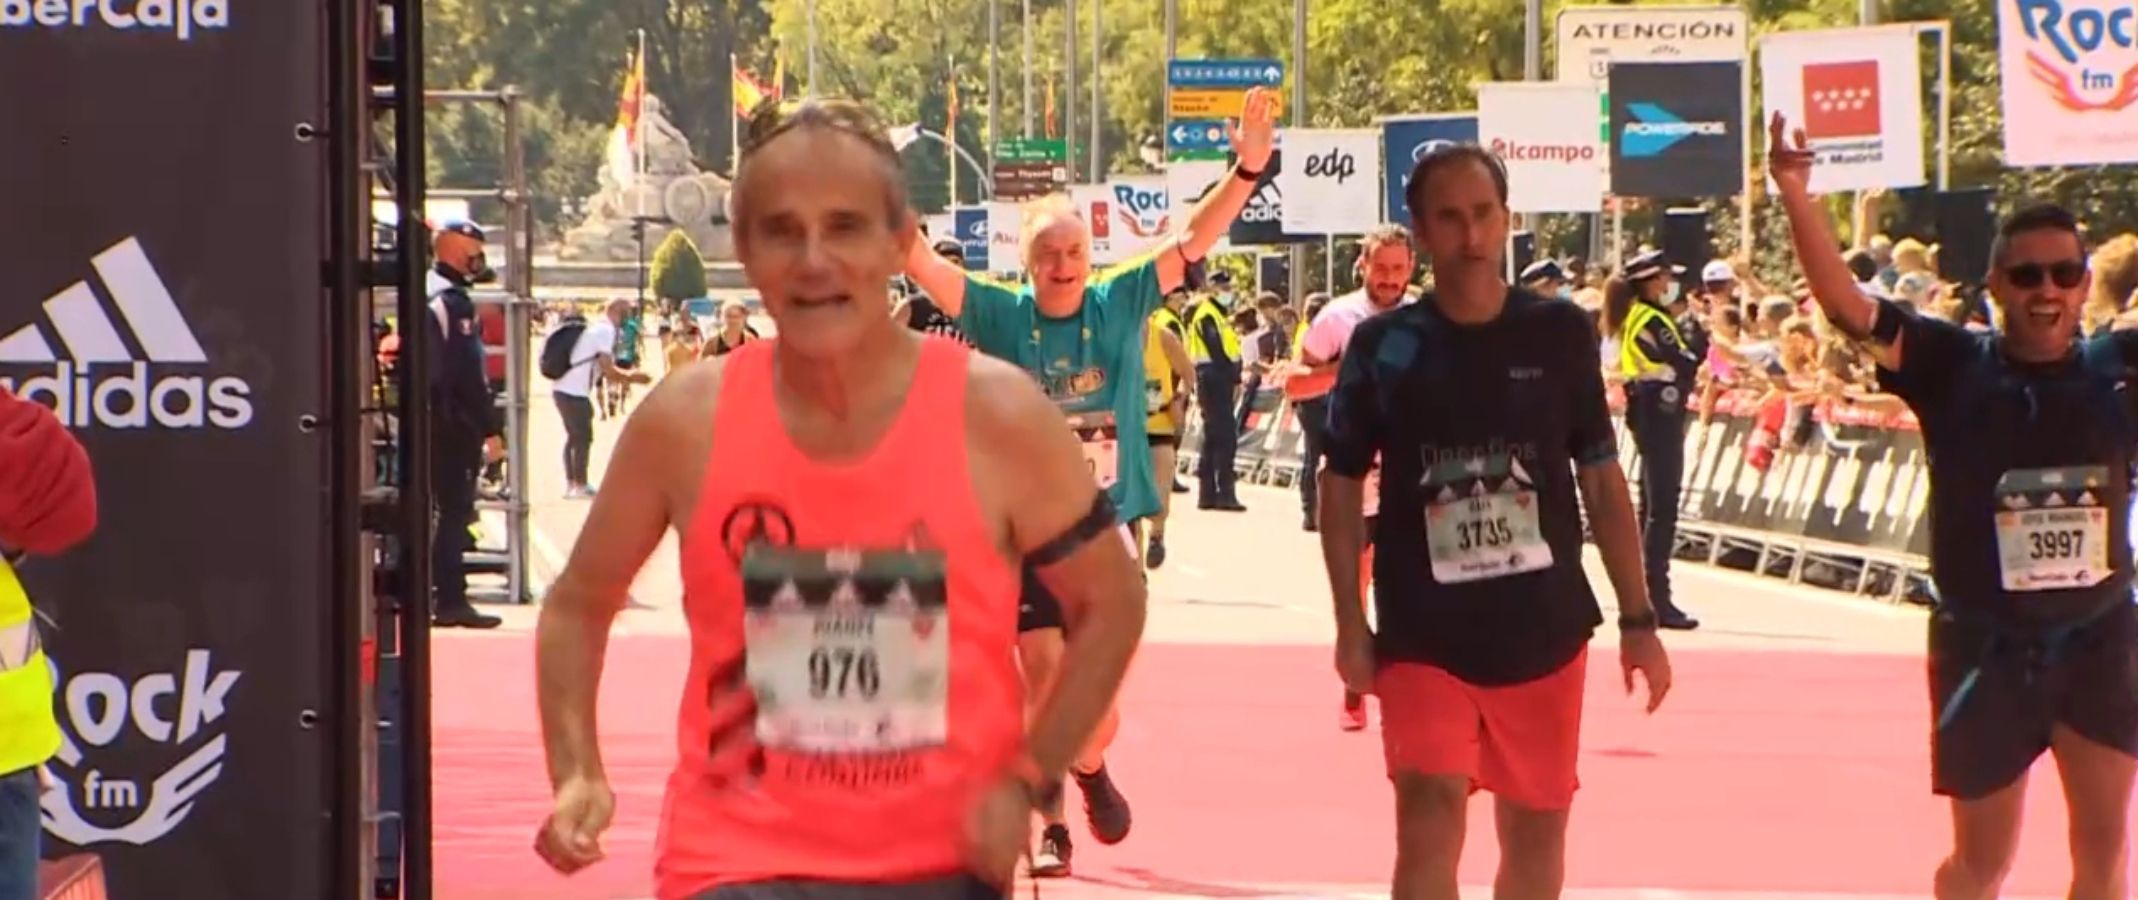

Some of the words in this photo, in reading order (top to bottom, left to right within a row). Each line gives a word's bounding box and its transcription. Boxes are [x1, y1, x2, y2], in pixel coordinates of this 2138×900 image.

[1573, 21, 1734, 39] ATENCIÓN
[2015, 0, 2138, 63] Roc
[2082, 69, 2113, 89] fm
[1304, 147, 1355, 184] edp
[1492, 138, 1594, 164] Alcampo
[1114, 185, 1168, 215] Roc
[0, 362, 253, 428] didas
[1457, 517, 1512, 550] 3735
[2029, 529, 2084, 560] 3997
[809, 648, 880, 700] 976
[45, 649, 242, 768] ock
[84, 770, 137, 807] fm
